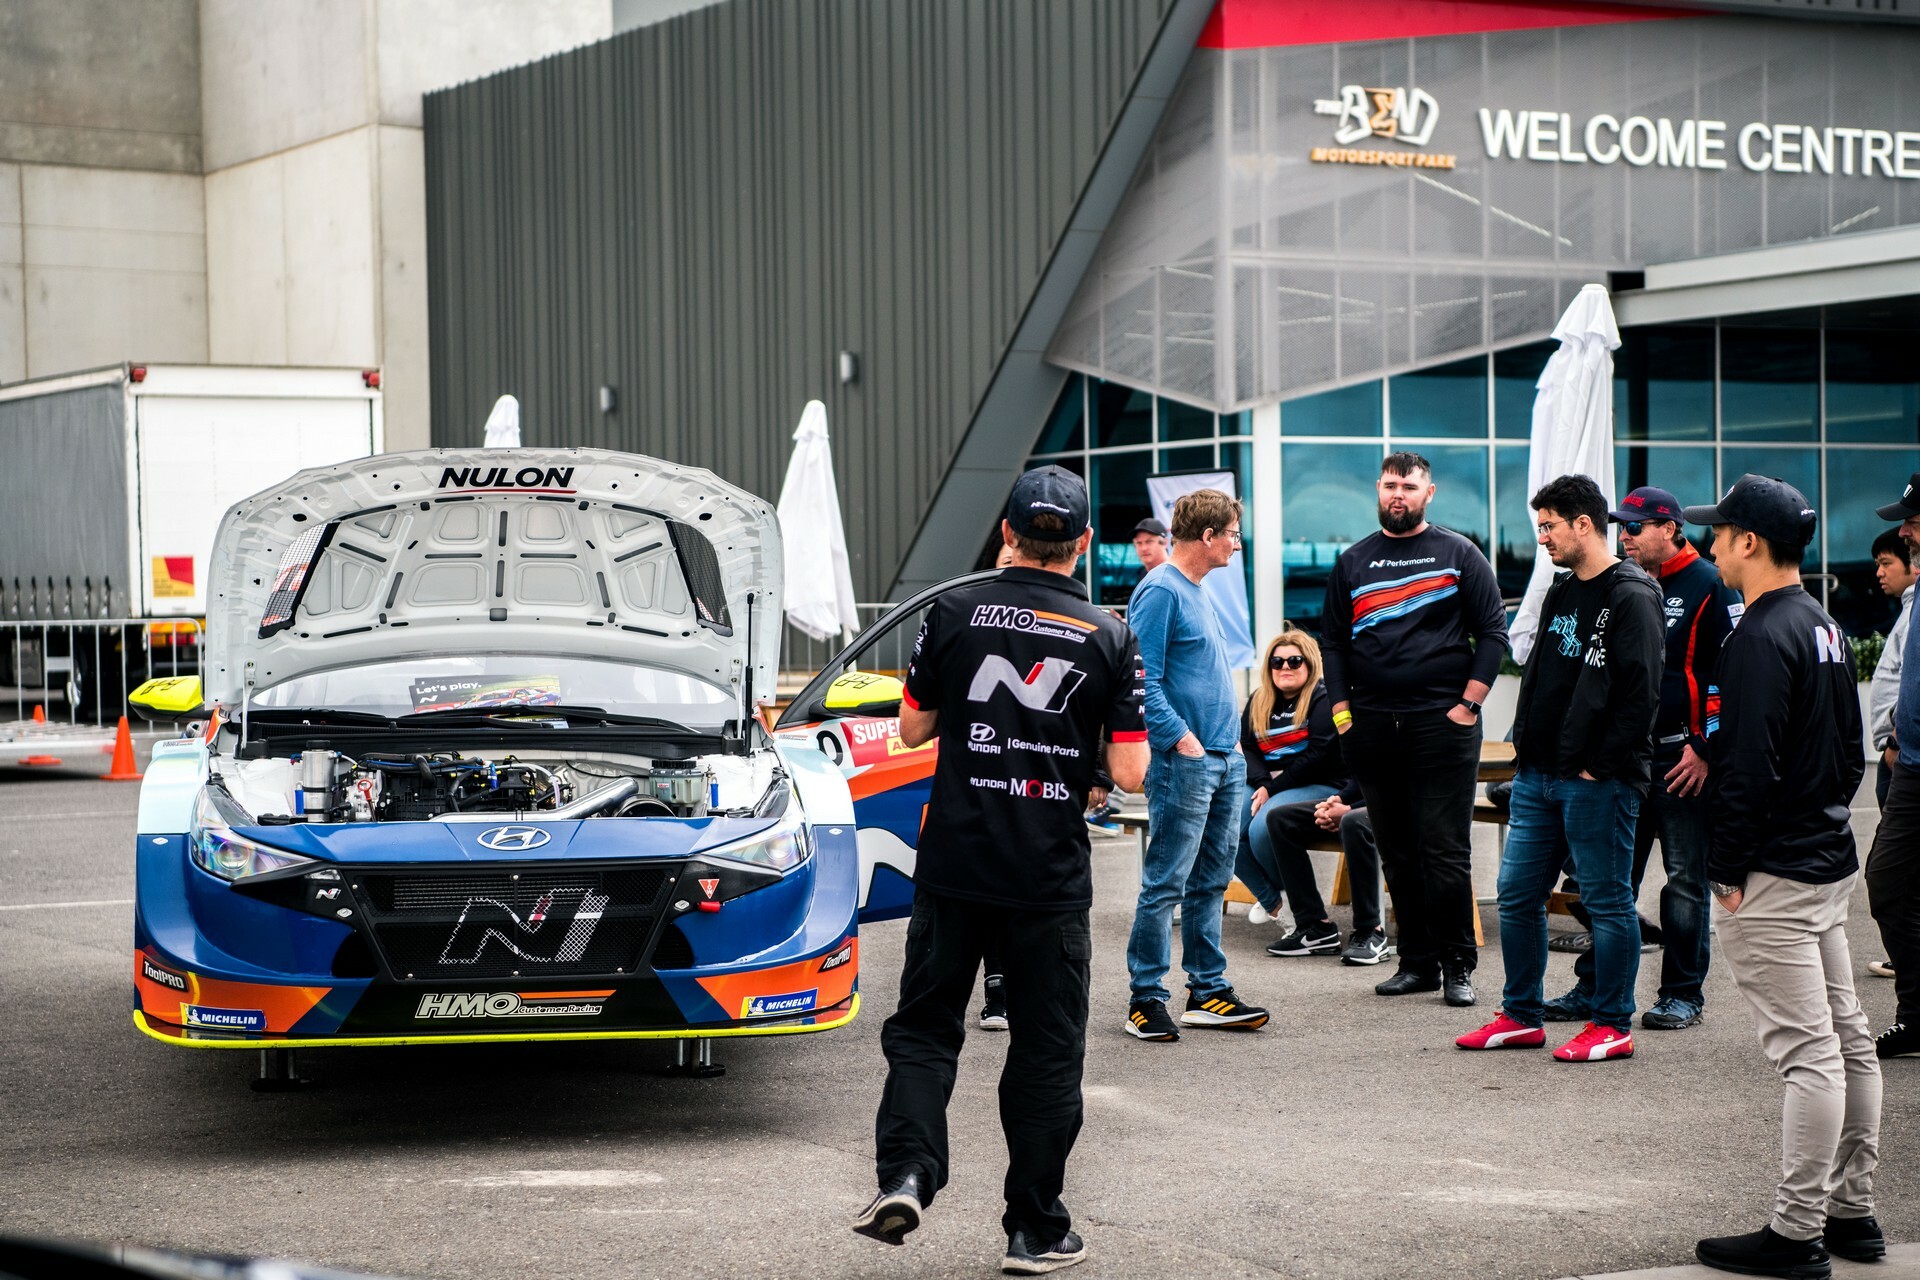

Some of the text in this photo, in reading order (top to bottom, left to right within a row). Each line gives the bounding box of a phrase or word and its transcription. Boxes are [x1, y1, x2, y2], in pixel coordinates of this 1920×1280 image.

[1478, 107, 1920, 179] WELCOME CENTRE
[1311, 147, 1457, 169] MOTORSPORT PARK
[437, 467, 575, 489] NULON
[1386, 556, 1436, 567] Performance
[969, 605, 1037, 631] HMO
[1033, 624, 1065, 636] Customer
[416, 682, 482, 695] Let's play.
[1011, 738, 1080, 758] Genuine Parts
[1009, 777, 1070, 801] MOBIS
[143, 960, 185, 989] ToolPRO
[415, 992, 522, 1018] HMO
[518, 1005, 567, 1014] Customer
[765, 995, 812, 1010] MICHELIN
[201, 1013, 258, 1025] MICHELIN
